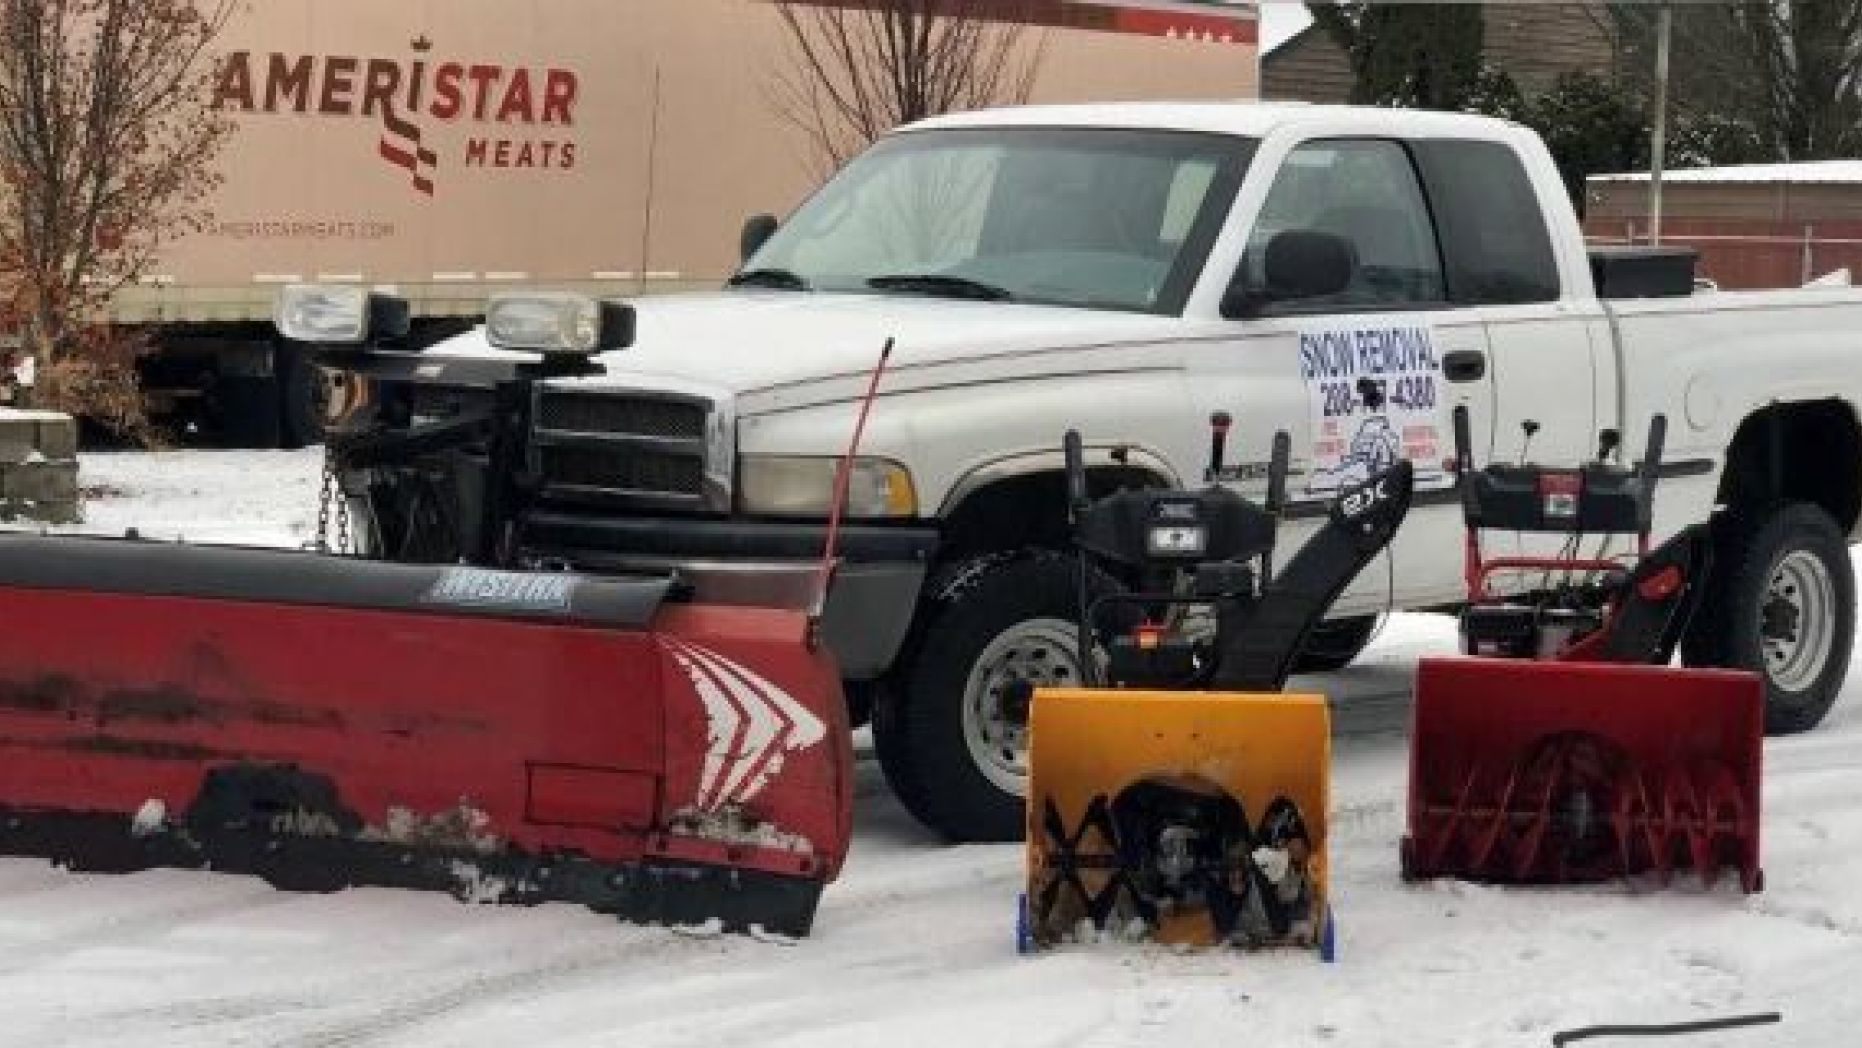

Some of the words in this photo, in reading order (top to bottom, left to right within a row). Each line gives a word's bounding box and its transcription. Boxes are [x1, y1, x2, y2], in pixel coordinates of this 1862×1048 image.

[213, 50, 579, 126] AMERISTAR
[464, 139, 577, 170] MEATS
[1300, 332, 1354, 380] SNOW
[1356, 328, 1439, 374] REMOVAL
